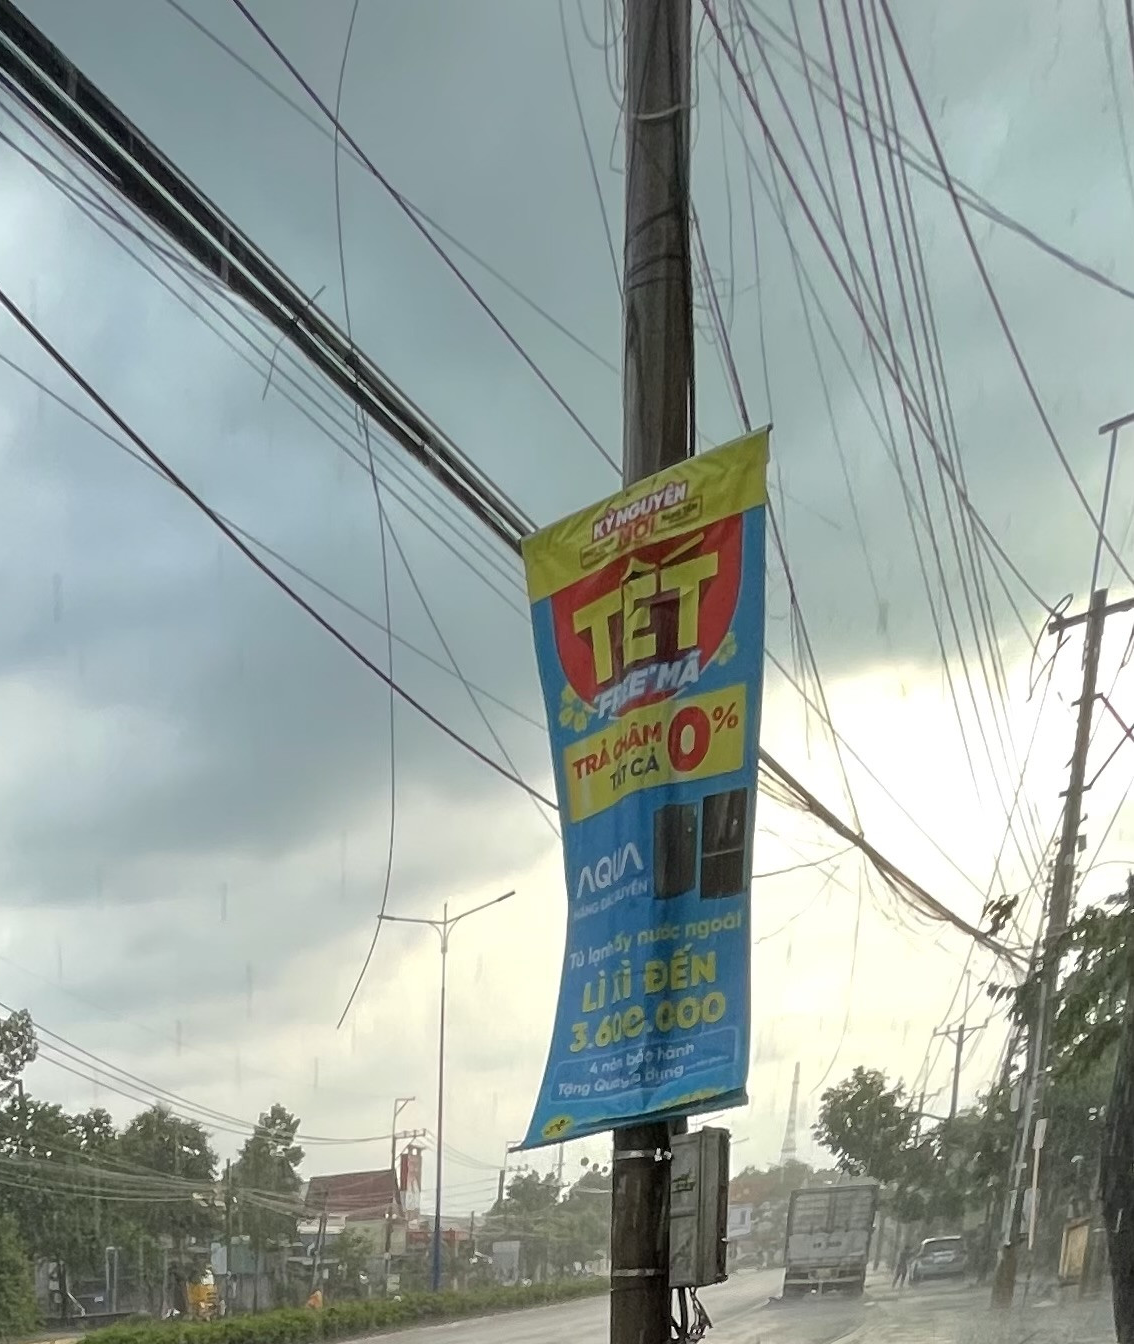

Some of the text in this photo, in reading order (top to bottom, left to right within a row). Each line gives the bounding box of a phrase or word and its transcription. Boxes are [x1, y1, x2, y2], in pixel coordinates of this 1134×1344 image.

[573, 532, 719, 684] TẾT
[572, 738, 612, 780] TRẢ
[630, 746, 661, 777] CẢ
